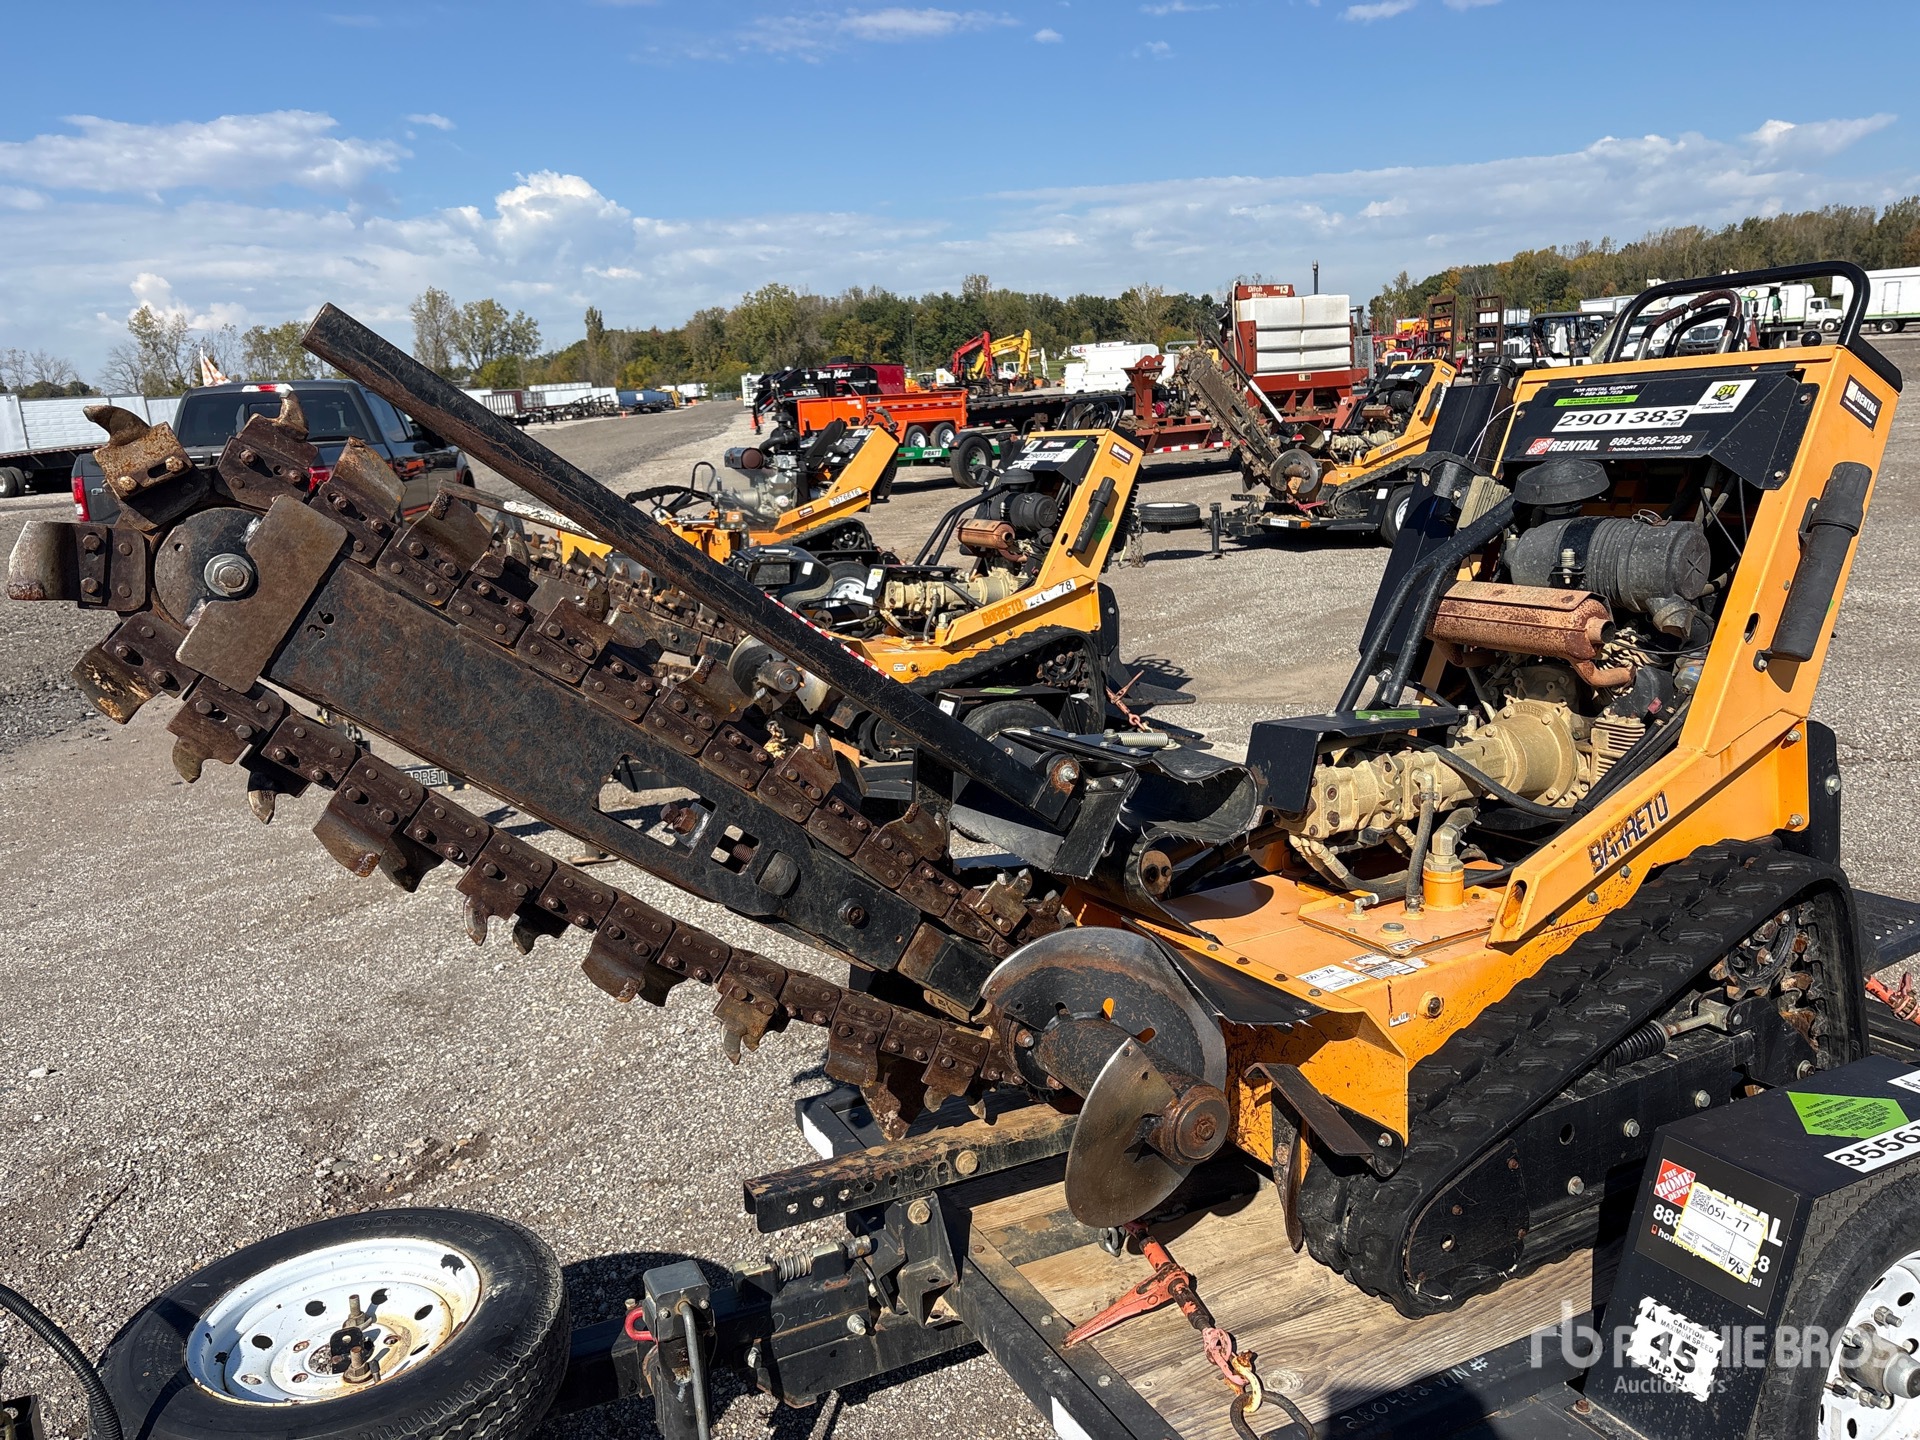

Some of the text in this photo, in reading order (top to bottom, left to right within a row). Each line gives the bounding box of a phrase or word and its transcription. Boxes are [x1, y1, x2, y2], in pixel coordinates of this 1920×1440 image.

[1716, 384, 1741, 396] 811
[1855, 390, 1877, 417] RENTAL
[1557, 409, 1688, 427] 2901383
[1547, 439, 1601, 452] RENTAL
[1609, 434, 1693, 446] 888-266-7228
[1587, 789, 1669, 877] BARRETO
[1655, 1170, 1696, 1198] HOME
[1662, 1168, 1679, 1181] THE
[1707, 1204, 1750, 1233] 051-77
[1660, 1319, 1714, 1354] MAXIMUM SPEED
[1673, 1319, 1706, 1341] CAUTION
[1649, 1331, 1699, 1374] 45
[1435, 1364, 1472, 1388] VIN
